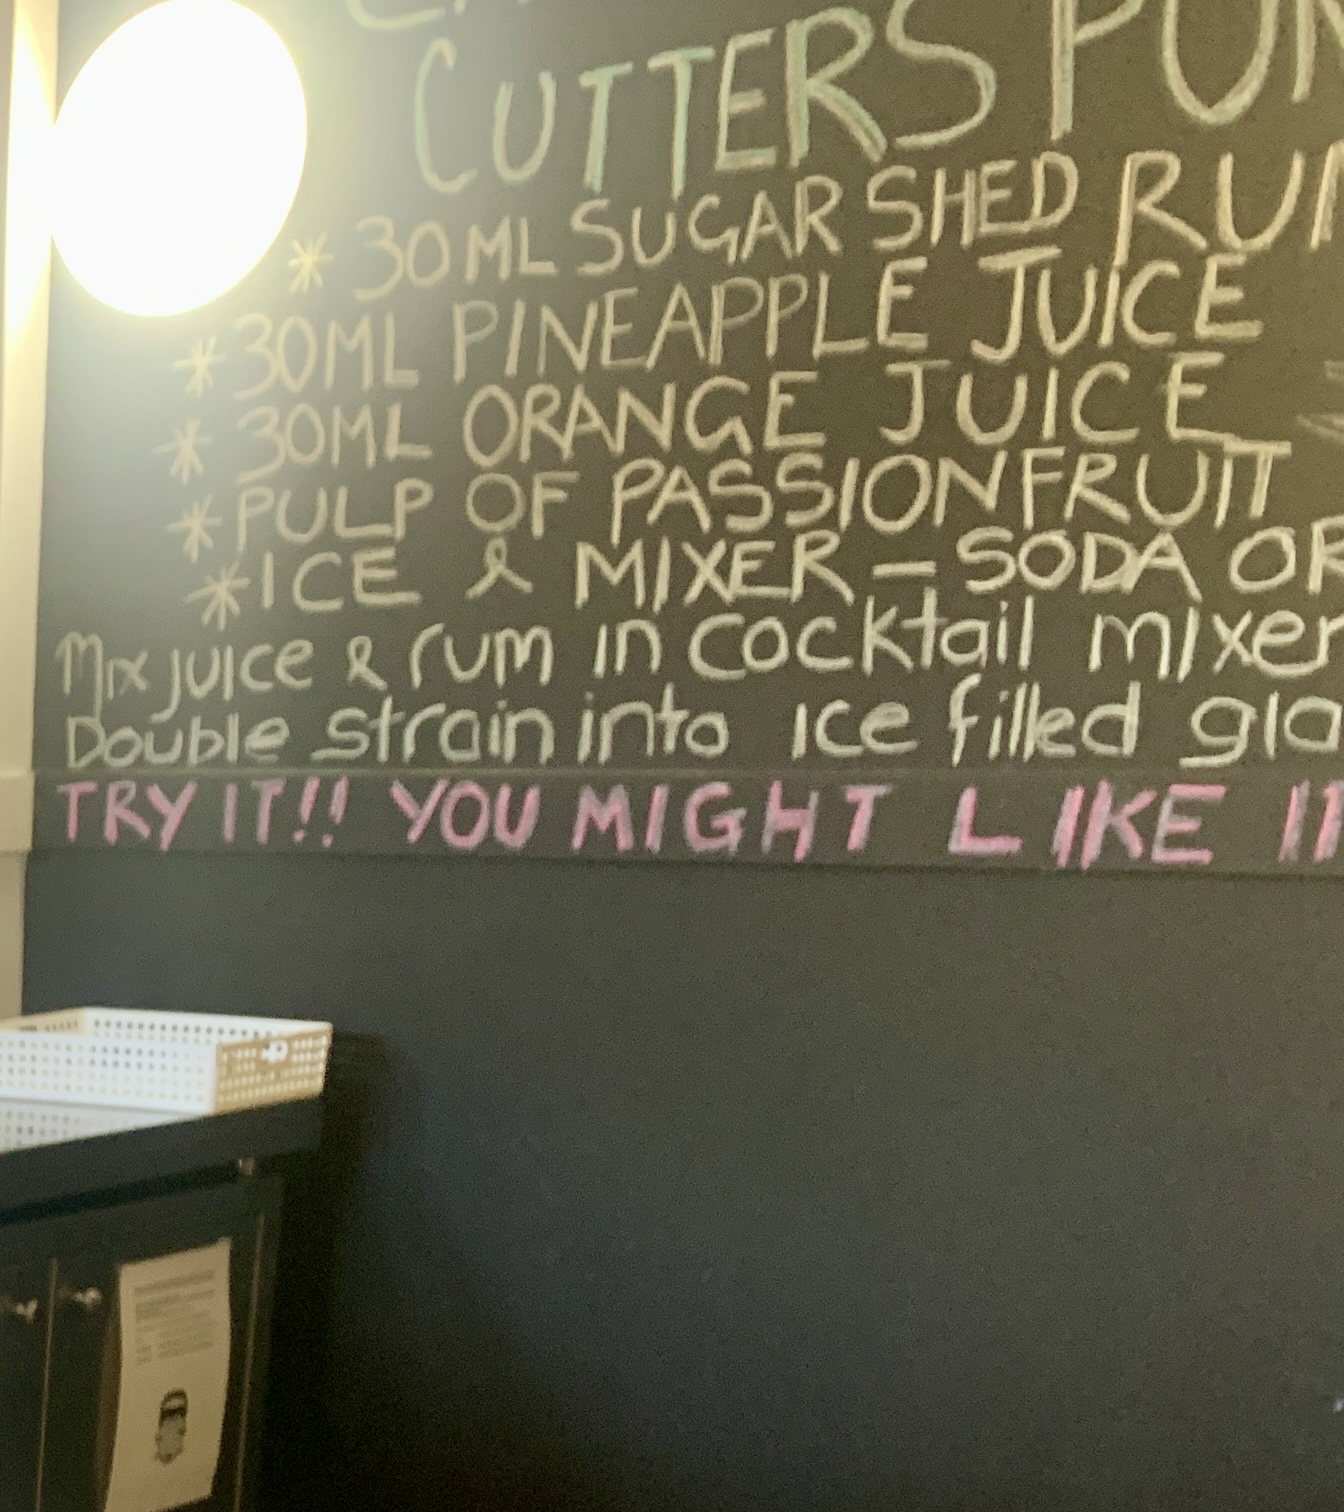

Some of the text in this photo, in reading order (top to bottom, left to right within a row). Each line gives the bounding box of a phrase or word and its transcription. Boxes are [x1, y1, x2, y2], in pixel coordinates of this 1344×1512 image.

[414, 0, 997, 199] CUTTERS
[354, 215, 558, 301] 30ML
[571, 175, 842, 276] SUGAR
[867, 150, 1079, 250] SHED
[233, 245, 1263, 399] 30ML PINEAPPLE JUICE
[238, 351, 1230, 484] 30ML ORANGE JUICE
[238, 478, 433, 551] PULP
[466, 471, 580, 538] OF
[261, 546, 421, 610] ICE
[466, 538, 531, 599] &
[574, 530, 854, 613] MIXER
[956, 526, 1202, 601] SODA
[411, 622, 554, 690] rum
[593, 619, 663, 677] in
[578, 683, 729, 765] into
[793, 698, 917, 760] ice
[949, 673, 1142, 766] filled
[58, 780, 199, 851] TRY
[222, 777, 348, 848] IT!!
[390, 779, 541, 851] YOU
[572, 780, 896, 862] MIGHT
[947, 779, 1226, 869] LIKE
